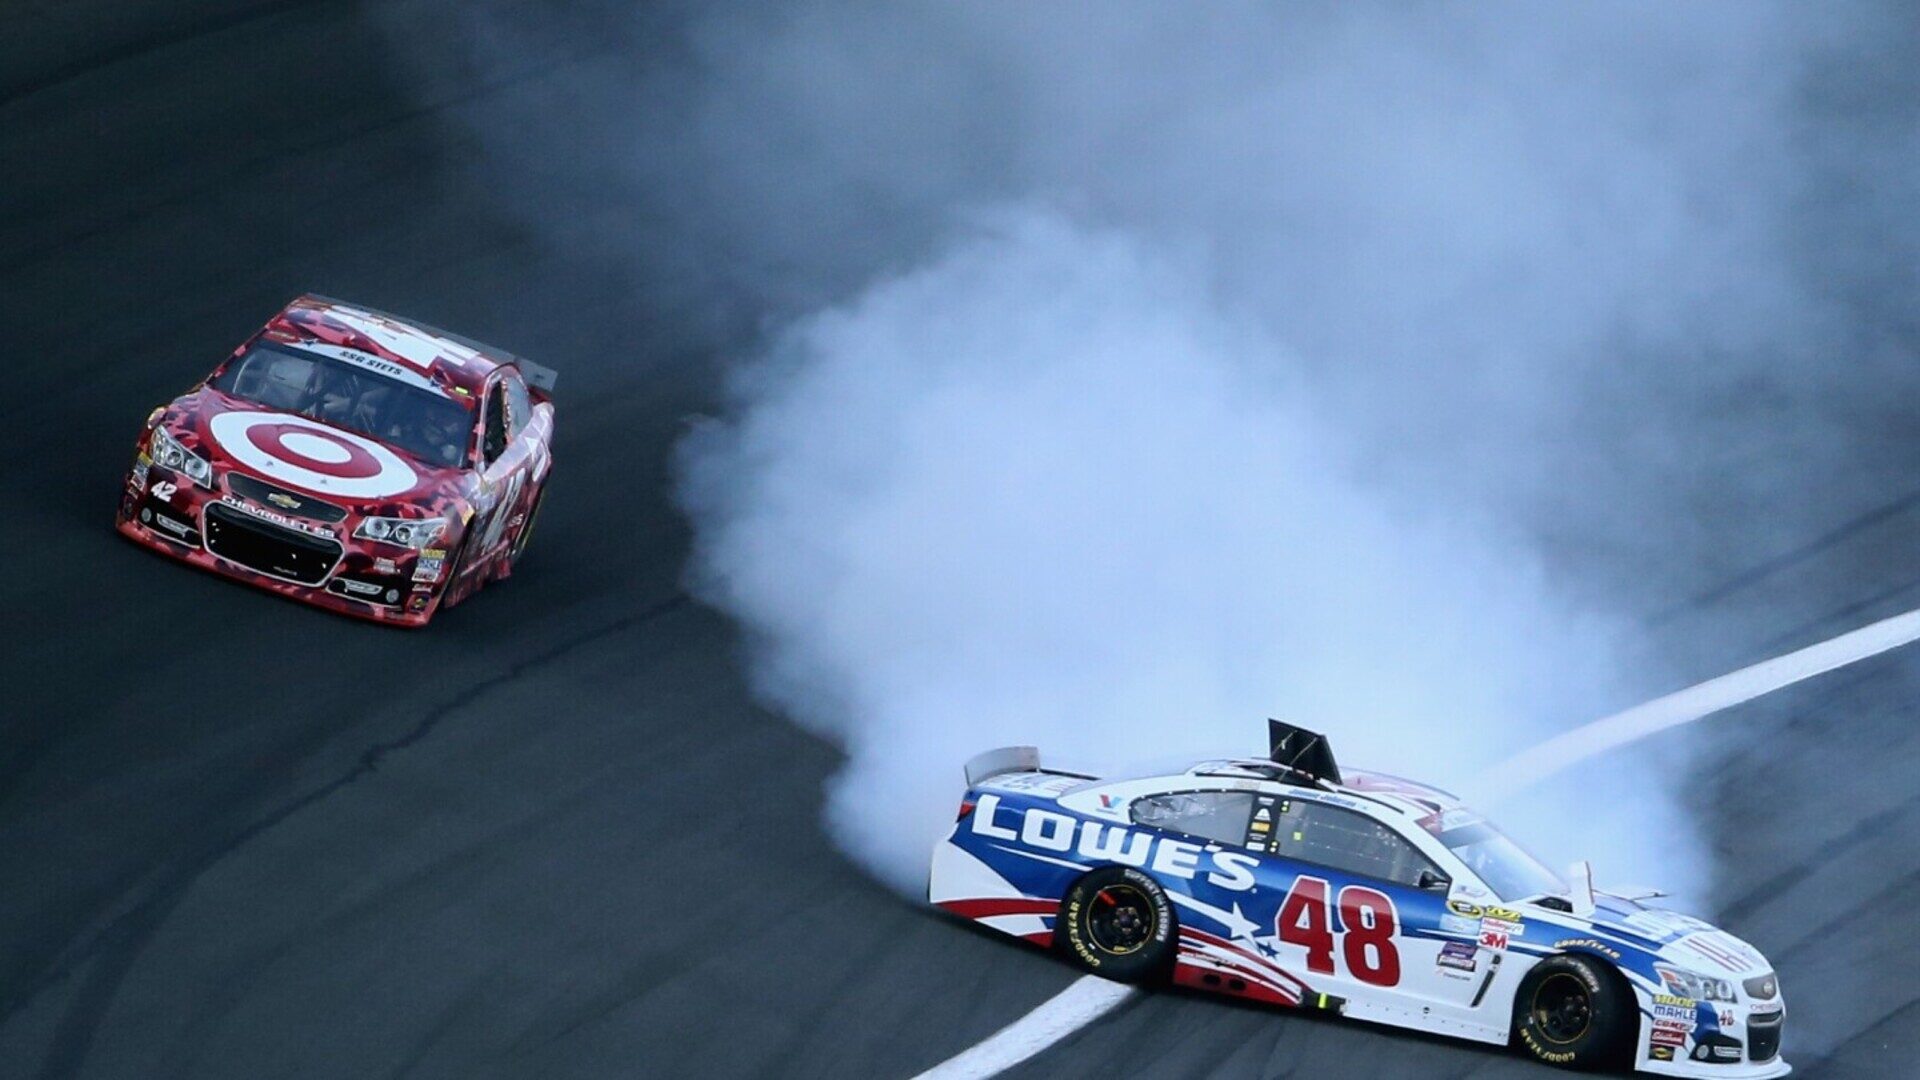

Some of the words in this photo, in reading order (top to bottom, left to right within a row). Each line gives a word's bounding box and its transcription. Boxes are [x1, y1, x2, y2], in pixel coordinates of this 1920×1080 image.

[151, 480, 178, 503] 42
[222, 494, 308, 532] CHEVROLET
[971, 793, 1260, 892] LOWE'S
[1275, 874, 1401, 988] 48
[1480, 931, 1507, 949] 3M
[1654, 1005, 1696, 1020] MAHLE
